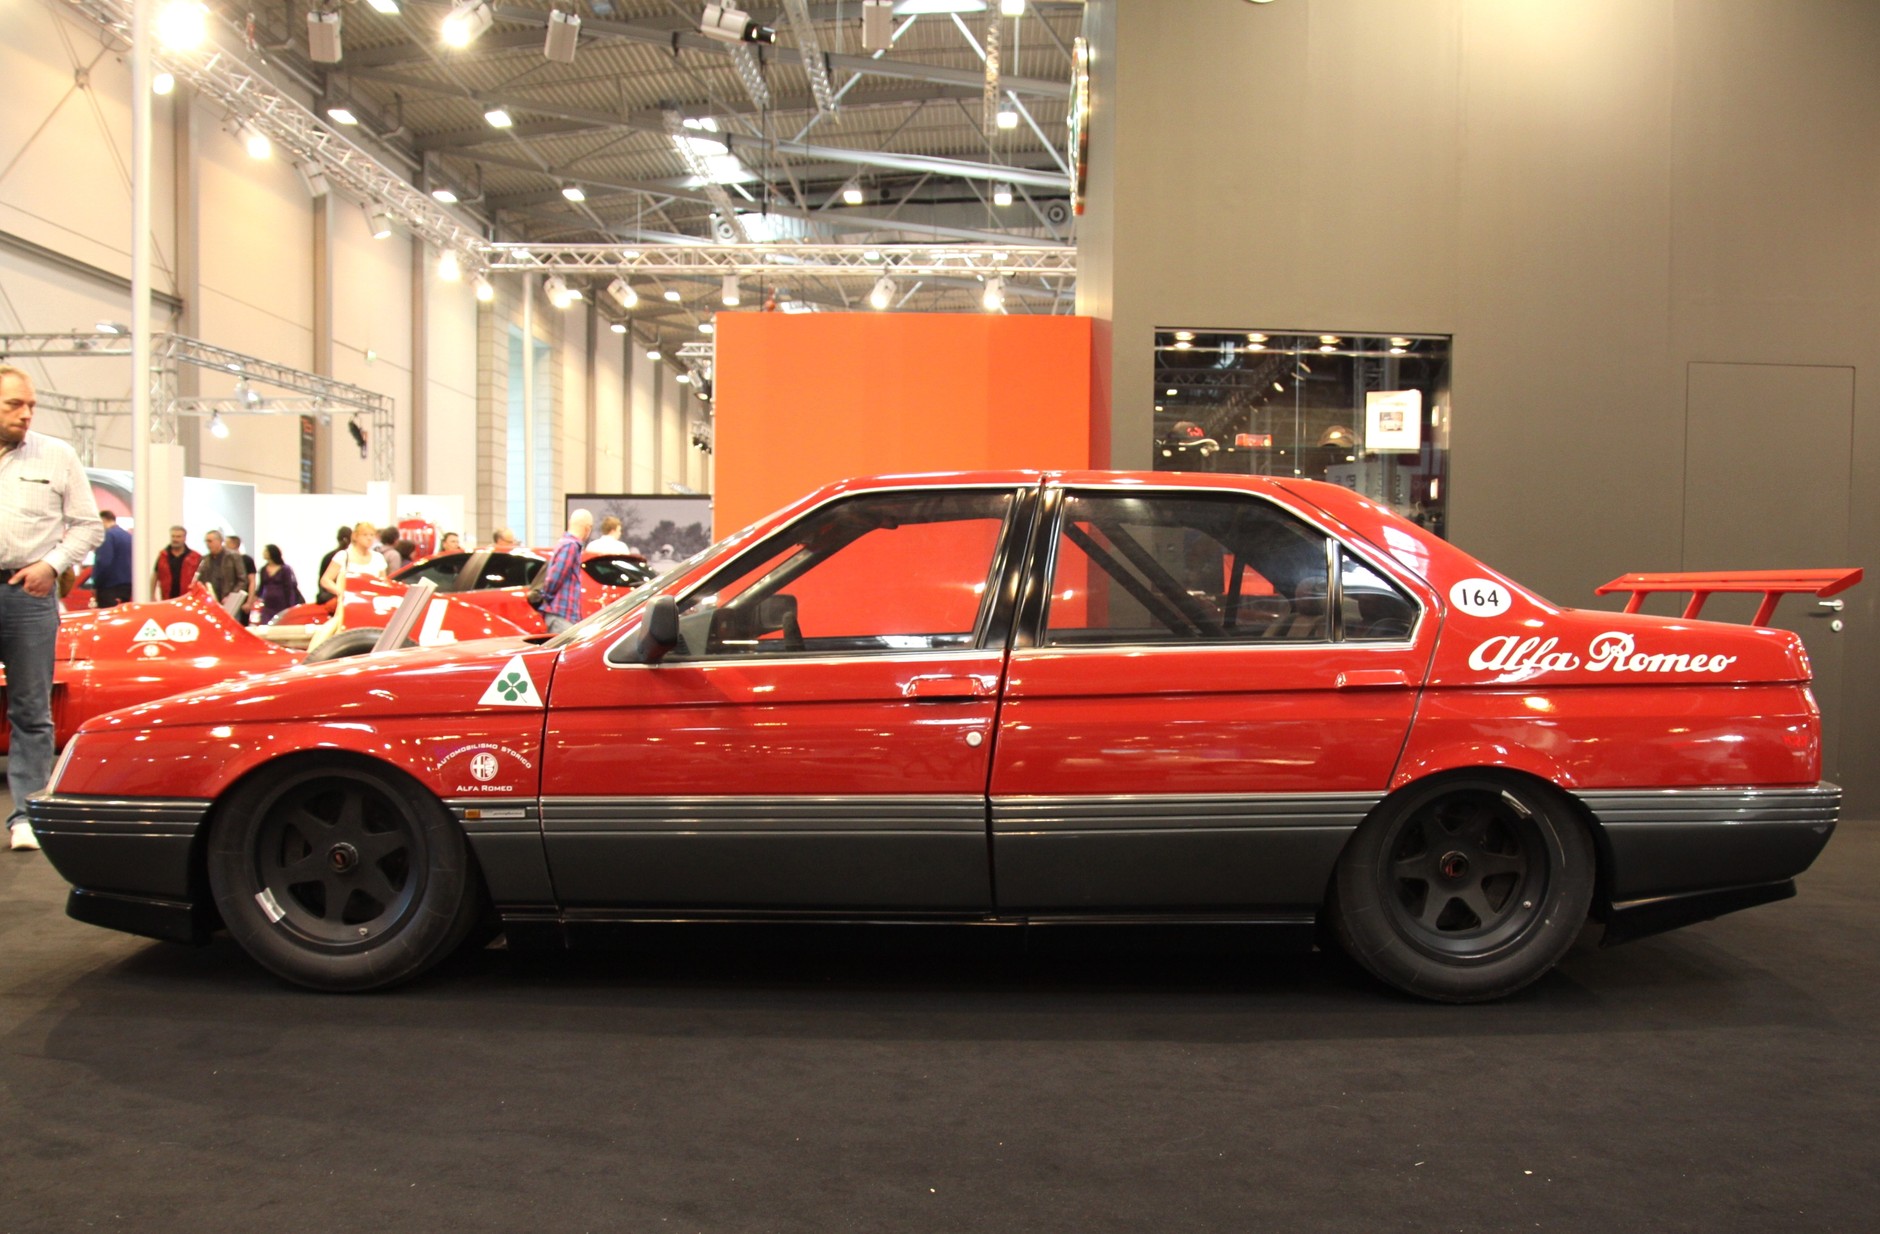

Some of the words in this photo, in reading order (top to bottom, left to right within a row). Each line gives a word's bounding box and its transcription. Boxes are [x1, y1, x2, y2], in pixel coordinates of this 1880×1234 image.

[1462, 588, 1499, 607] 164
[1468, 636, 1580, 671] Alfa
[1584, 631, 1737, 673] Romeo
[437, 743, 498, 769] AUTOMOBILISMO
[500, 746, 532, 769] STORICO
